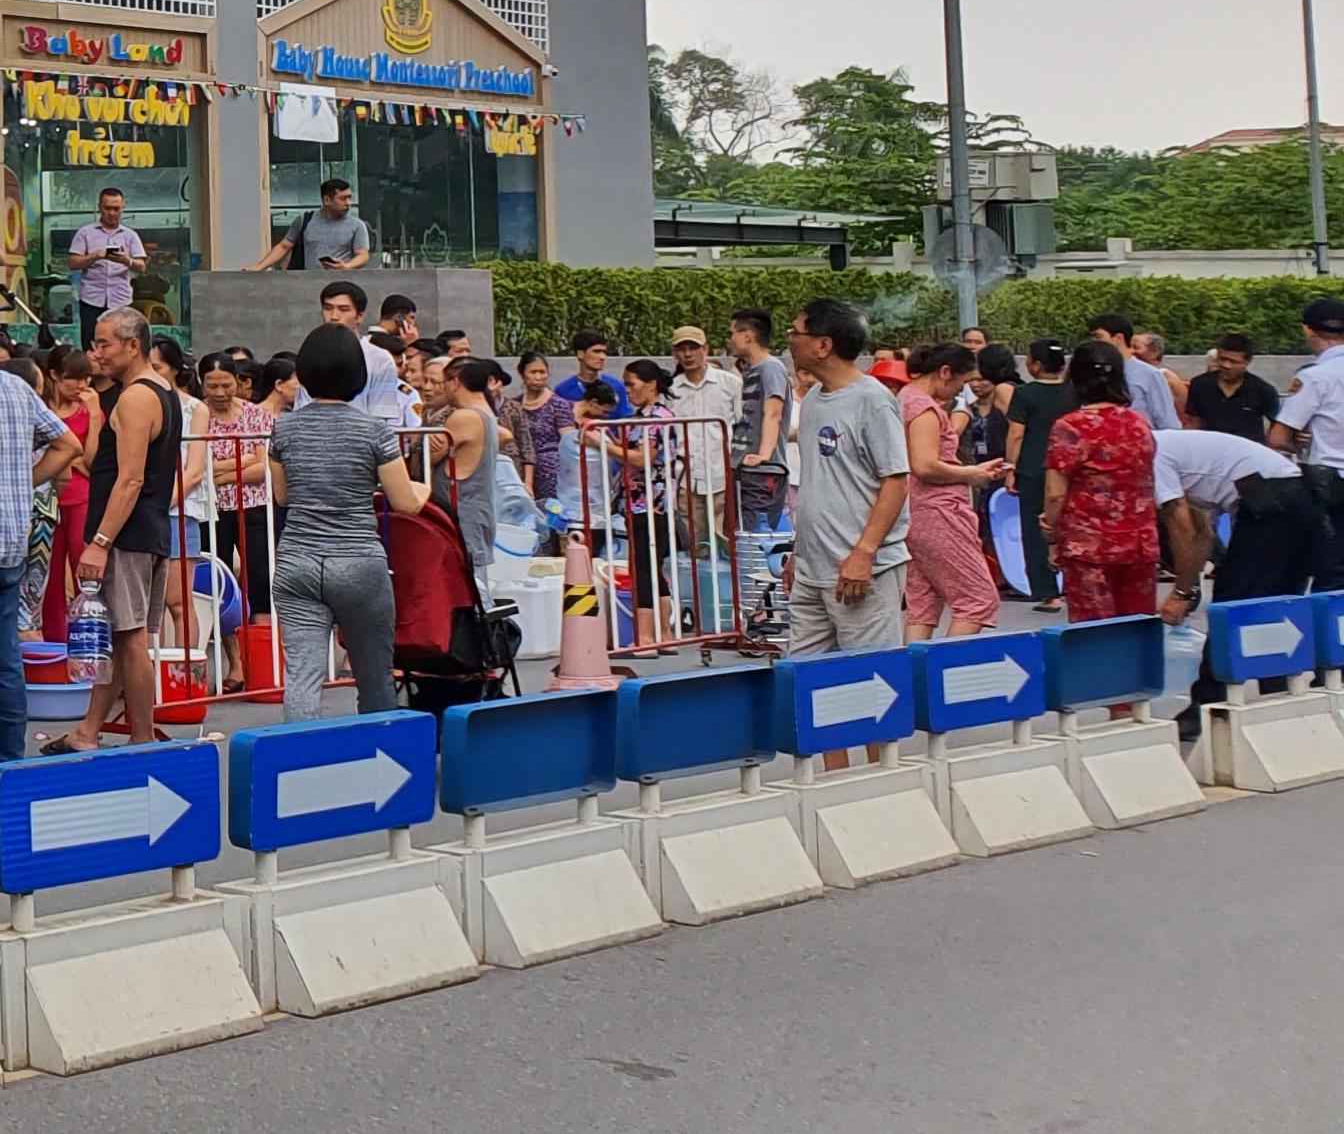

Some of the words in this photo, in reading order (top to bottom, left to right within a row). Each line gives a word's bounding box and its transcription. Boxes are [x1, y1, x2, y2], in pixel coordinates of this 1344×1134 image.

[20, 26, 104, 64] Baby
[108, 33, 183, 64] Land
[271, 39, 316, 81] Baby
[370, 52, 460, 90] Montessori
[460, 60, 535, 97] Preschool
[23, 80, 81, 121] Khu
[84, 94, 125, 123] vui
[113, 140, 155, 168] em
